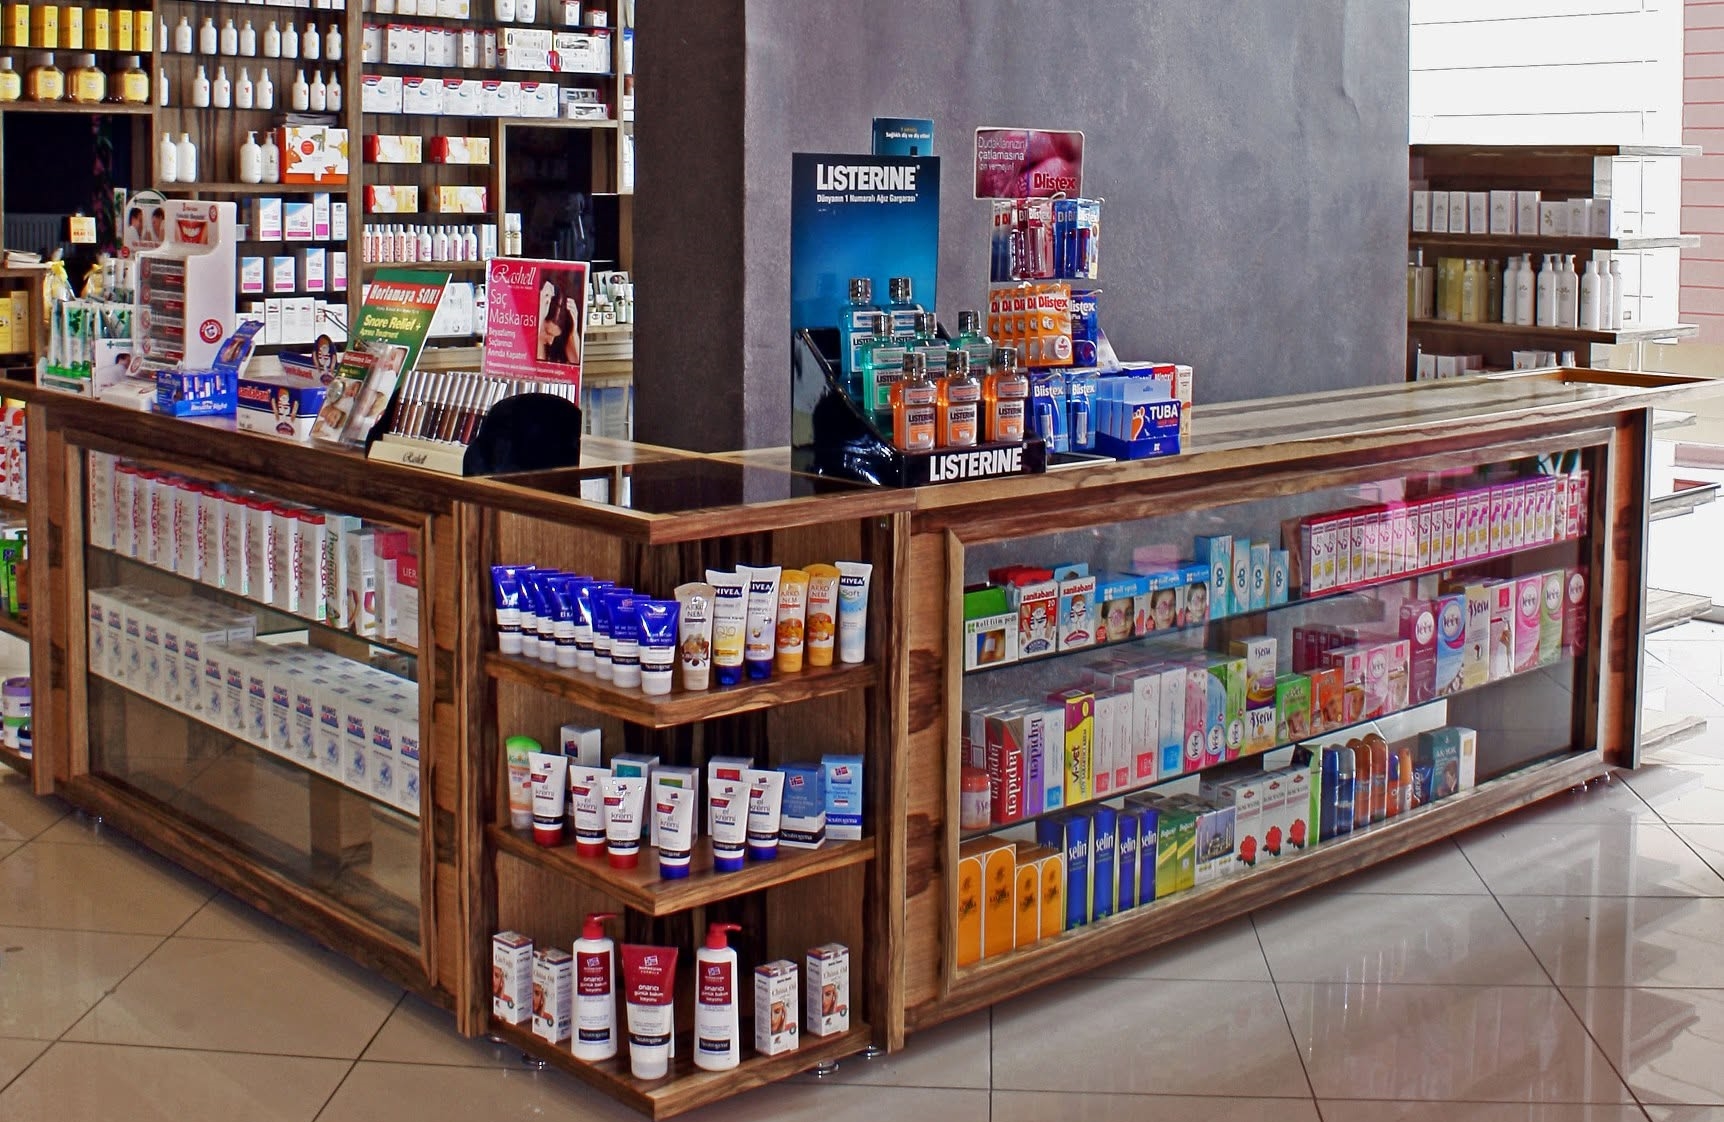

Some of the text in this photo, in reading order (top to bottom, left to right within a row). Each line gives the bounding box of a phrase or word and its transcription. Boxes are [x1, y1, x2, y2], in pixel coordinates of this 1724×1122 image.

[817, 164, 915, 190] LISTERINE
[817, 194, 844, 203] Dünyanın
[850, 194, 876, 202] Numaralı
[877, 194, 889, 204] Ağız
[491, 264, 537, 286] Rashell
[491, 288, 507, 310] Saç
[1070, 299, 1097, 315] listex
[363, 314, 388, 328] Snore
[388, 317, 416, 331] Relief
[489, 309, 537, 327] Maskarası
[1071, 382, 1096, 397] Blistex
[1149, 401, 1180, 420] TUBA
[930, 447, 1022, 482] LISTERINE
[403, 567, 417, 578] LIER
[750, 582, 772, 594] IVEA
[842, 588, 860, 598] Soft
[1023, 589, 1056, 603] sanitabant
[1062, 583, 1094, 598] sanitabant
[976, 618, 990, 630] Roll
[990, 615, 1003, 627] film
[1027, 718, 1043, 780] lapiden
[1005, 749, 1022, 818] lapiden
[1095, 832, 1114, 853] selin
[1120, 837, 1136, 855] selin
[1141, 830, 1157, 848] selin
[1068, 840, 1088, 861] selin
[583, 975, 604, 984] onarıcı
[638, 983, 660, 993] onarıcı
